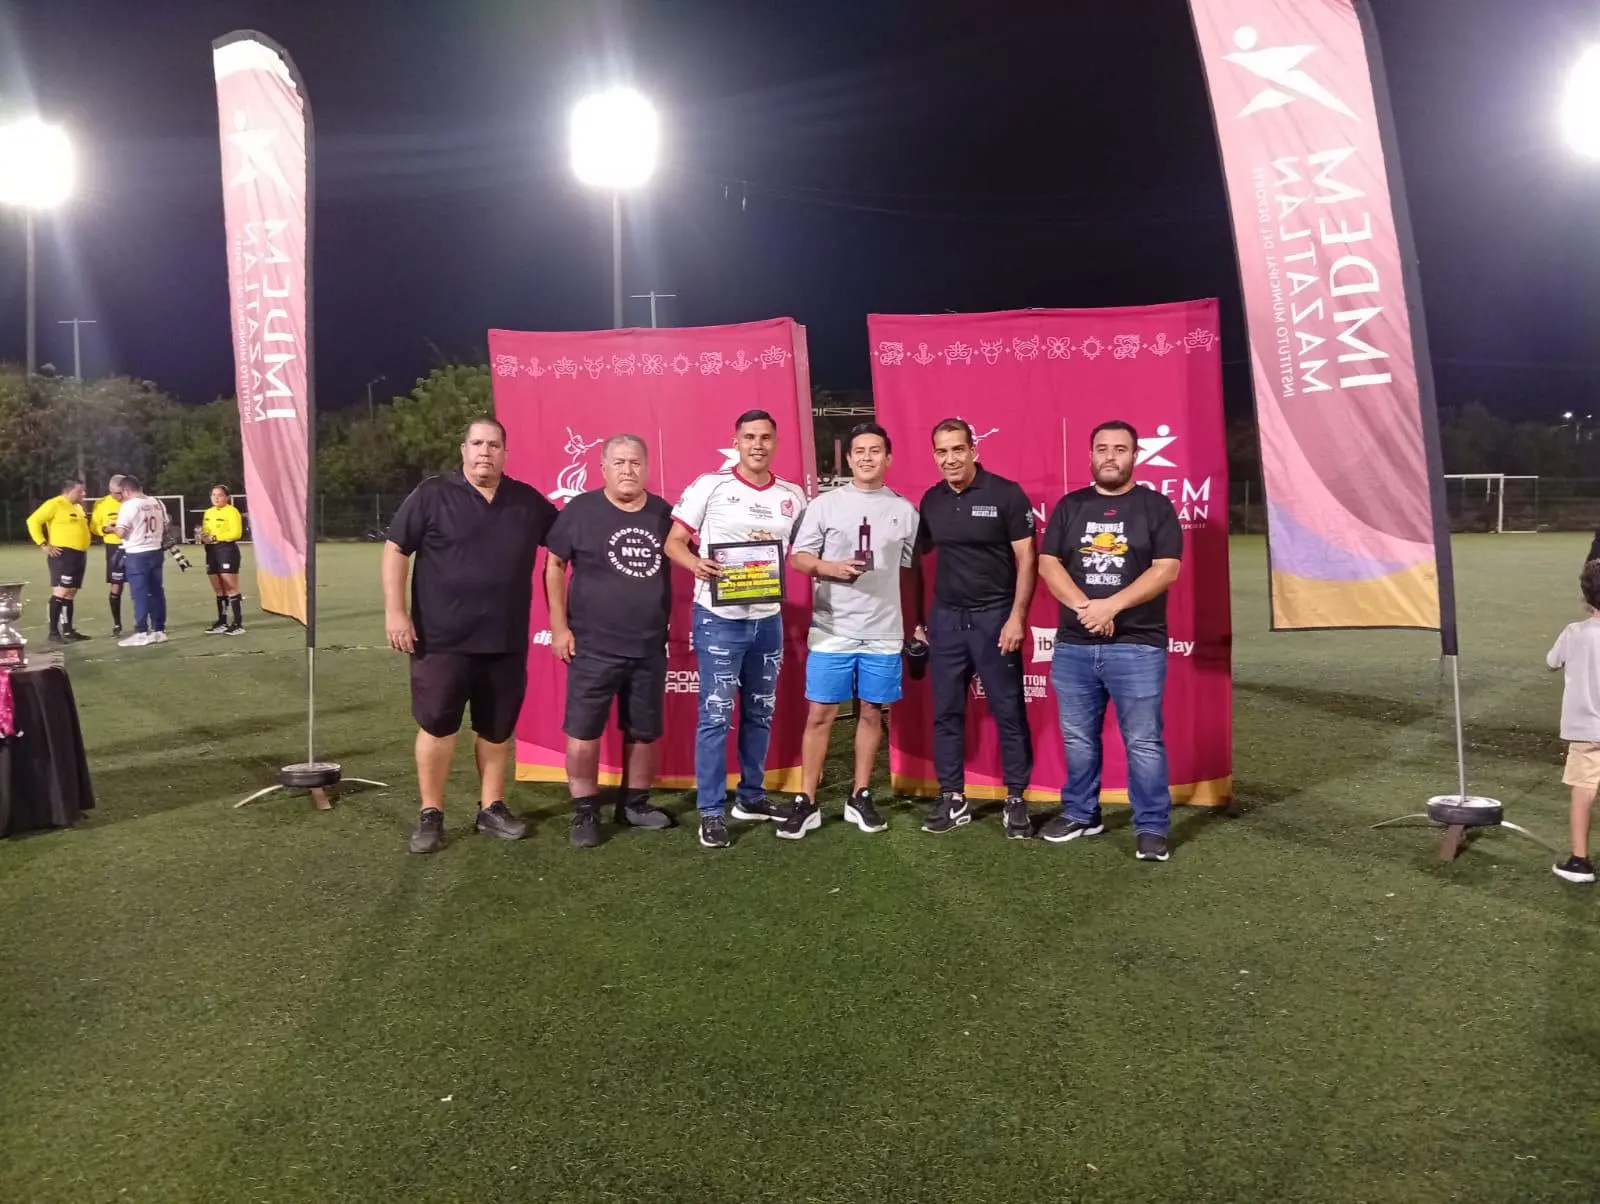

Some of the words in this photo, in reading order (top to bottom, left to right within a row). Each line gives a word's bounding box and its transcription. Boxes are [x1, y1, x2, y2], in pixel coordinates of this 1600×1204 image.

[144, 516, 157, 533] 10
[621, 546, 652, 558] NYC
[1038, 637, 1053, 651] ib
[1168, 637, 1195, 657] lay
[665, 671, 700, 682] POW
